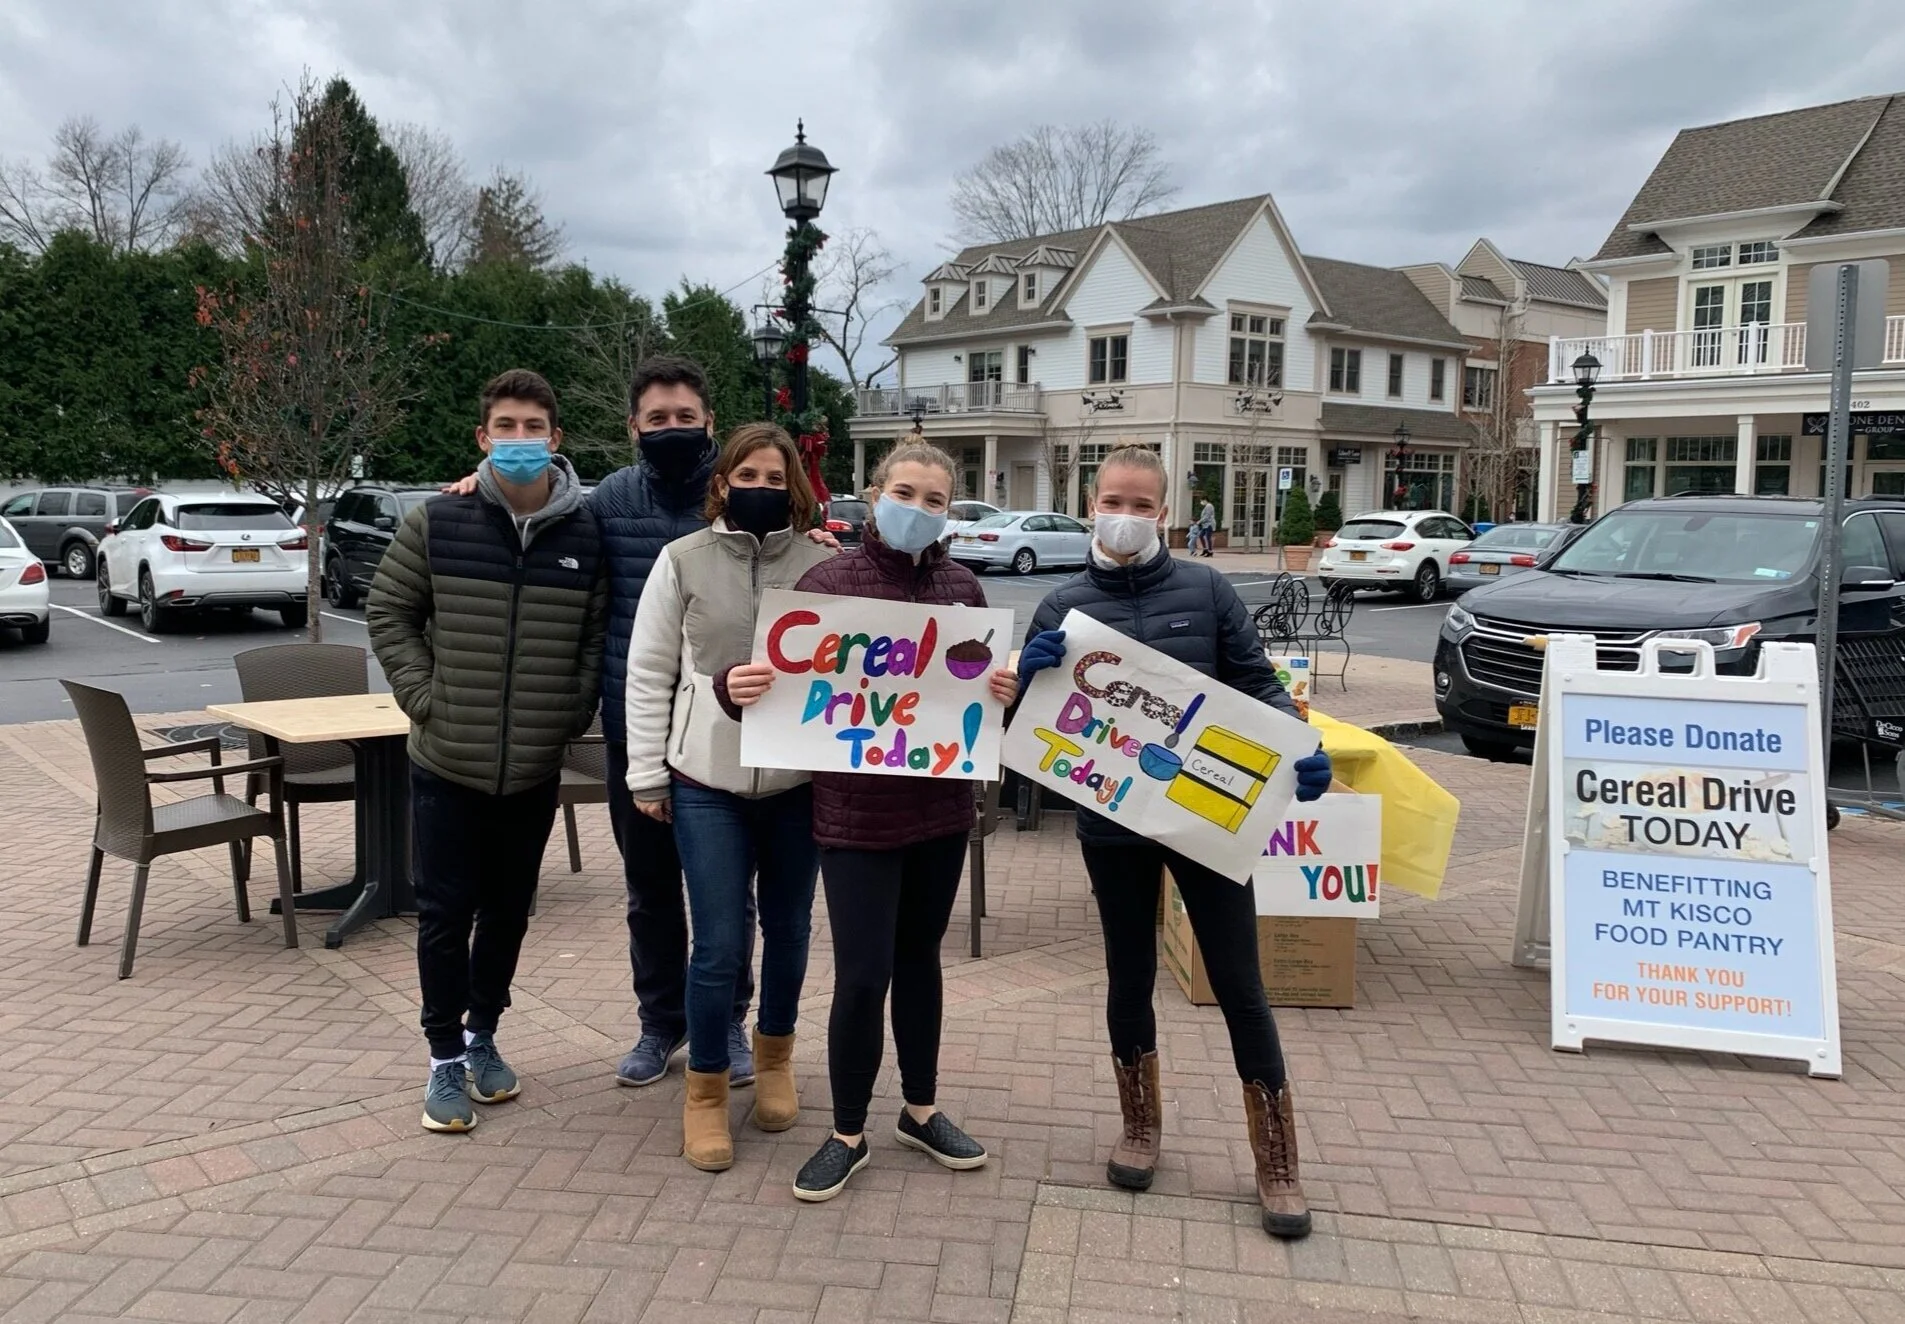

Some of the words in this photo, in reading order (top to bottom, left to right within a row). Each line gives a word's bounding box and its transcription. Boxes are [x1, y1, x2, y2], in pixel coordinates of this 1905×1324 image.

[767, 610, 938, 679] Cereal
[801, 678, 920, 727] Drive
[1073, 651, 1206, 738] Cereal
[835, 702, 983, 776] Today!
[1055, 692, 1142, 757] Drive
[1585, 718, 1673, 747] Please
[1685, 724, 1782, 753] Donate
[1034, 727, 1133, 812] Today!
[1191, 758, 1235, 787] Cereal
[1576, 769, 1686, 808] Cereal
[1702, 777, 1796, 815] Drive
[1619, 814, 1751, 850] TODAY
[1300, 864, 1379, 903] YOU!
[1602, 870, 1772, 900] BENEFITTING
[1623, 898, 1661, 918] MT
[1670, 902, 1752, 926] KISCO
[1595, 923, 1667, 946] FOOD
[1678, 930, 1784, 956] PANTRY
[1636, 960, 1699, 983] THANK
[1705, 967, 1745, 988] YOU
[1592, 983, 1630, 1001] FOR
[1636, 986, 1688, 1007] YOUR
[1694, 992, 1792, 1017] SUPPORT!
